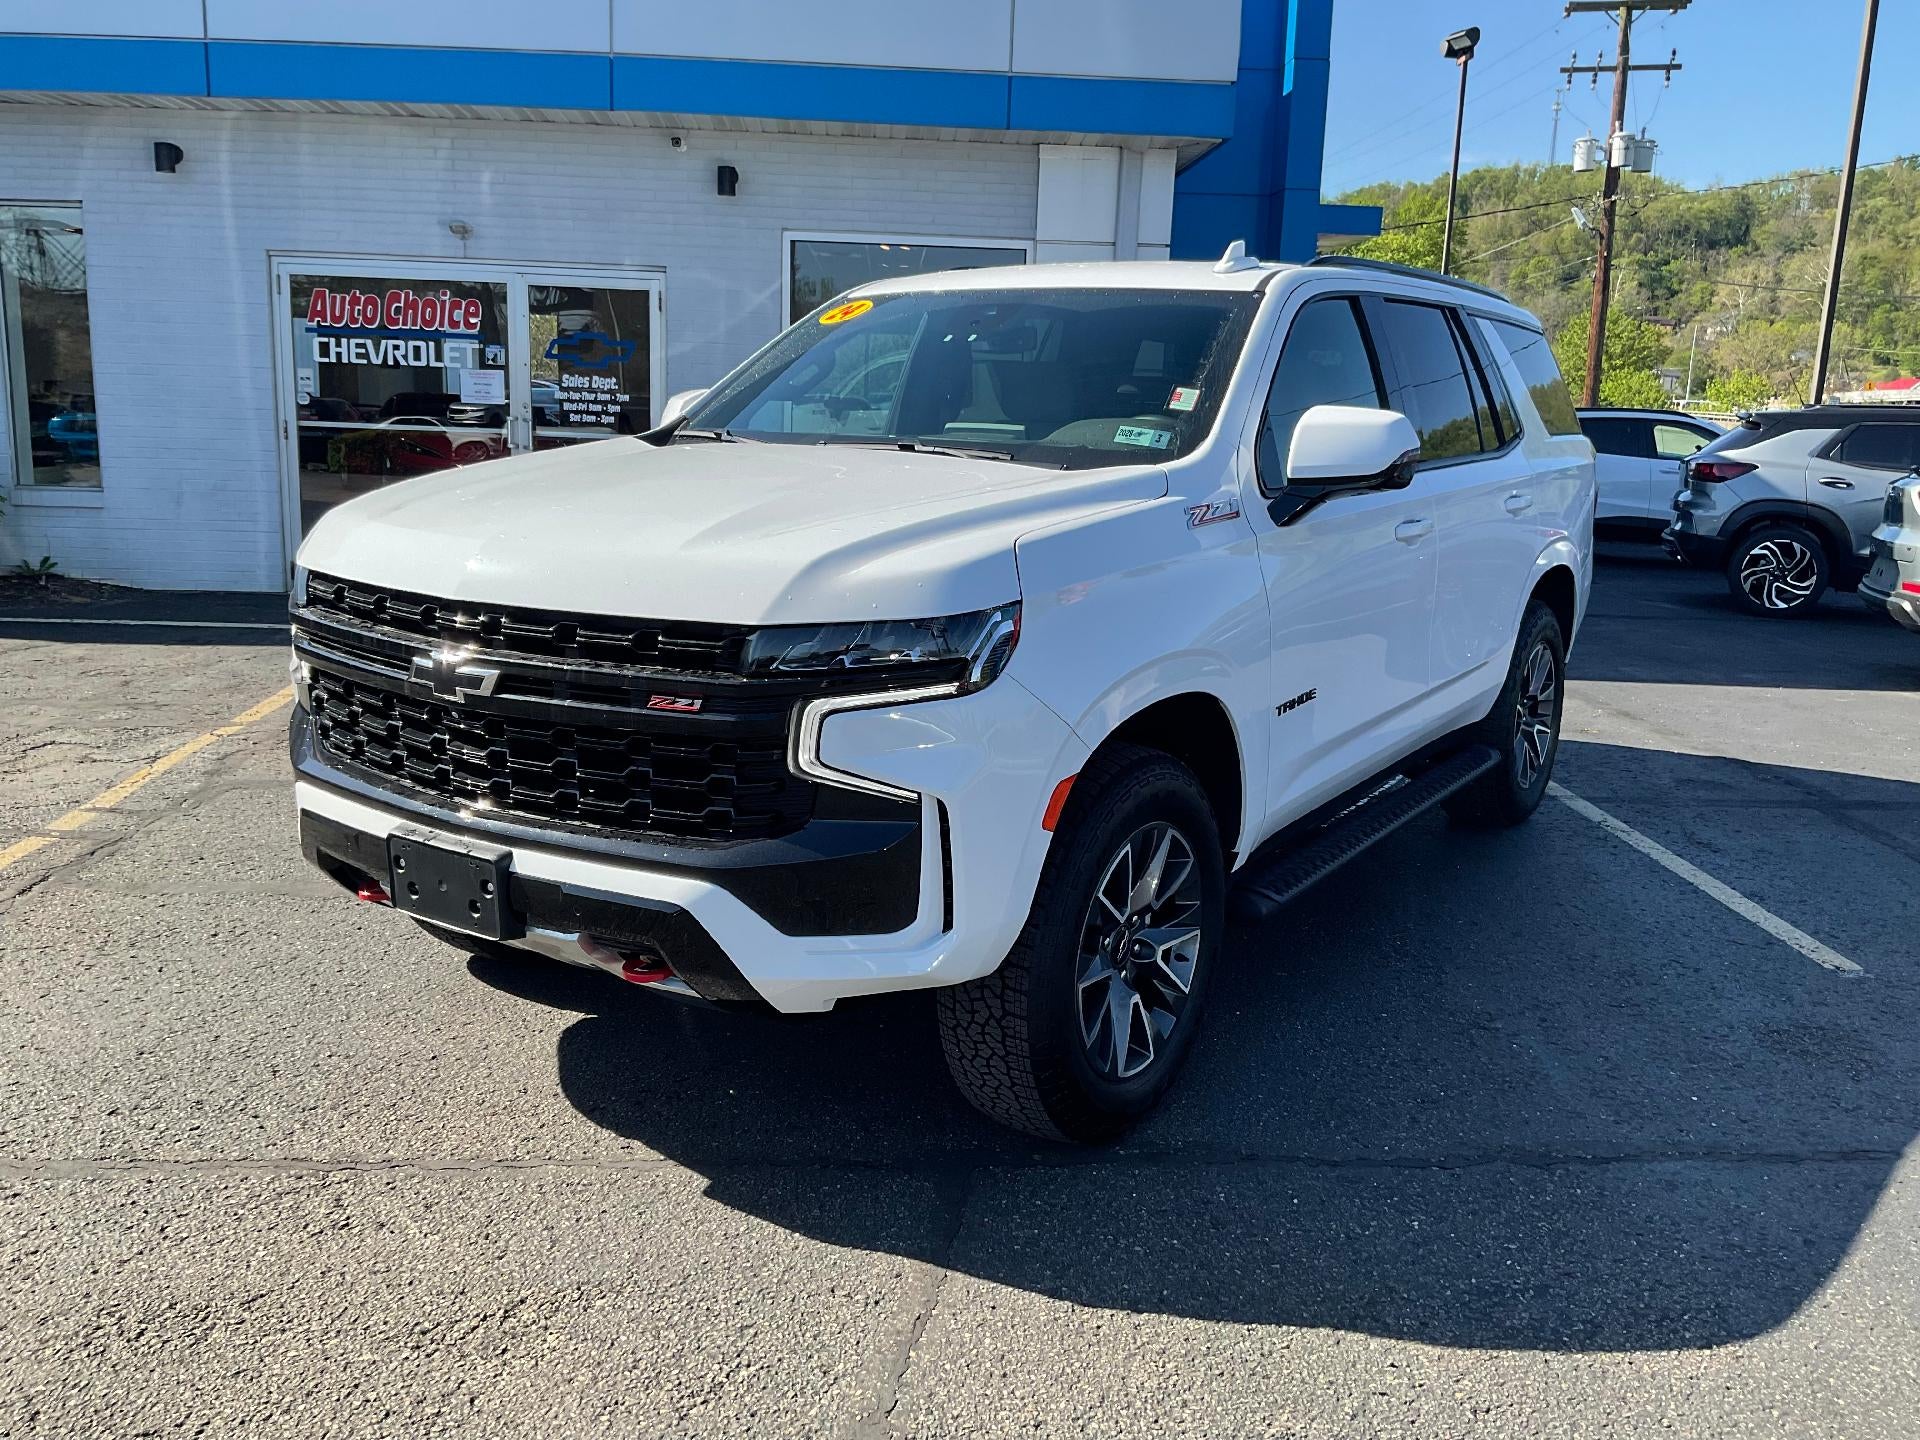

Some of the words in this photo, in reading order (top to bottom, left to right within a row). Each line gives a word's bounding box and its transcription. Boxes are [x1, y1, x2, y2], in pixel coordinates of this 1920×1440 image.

[307, 288, 381, 328] Auto
[384, 289, 482, 332] Choice
[313, 337, 484, 368] CHEVROLET
[561, 374, 590, 388] Sales
[591, 375, 619, 390] Dept.
[597, 393, 611, 401] 9am
[616, 393, 630, 402] 7pm
[563, 402, 588, 411] Wed-Fri
[588, 403, 602, 412] 9am
[607, 404, 621, 413] 5pm
[569, 413, 581, 422] Sat
[582, 414, 597, 423] 9am
[1155, 433, 1164, 443] 3
[1184, 498, 1240, 530] Z71
[647, 695, 703, 712] Z71
[1276, 687, 1318, 717] TAHOE
